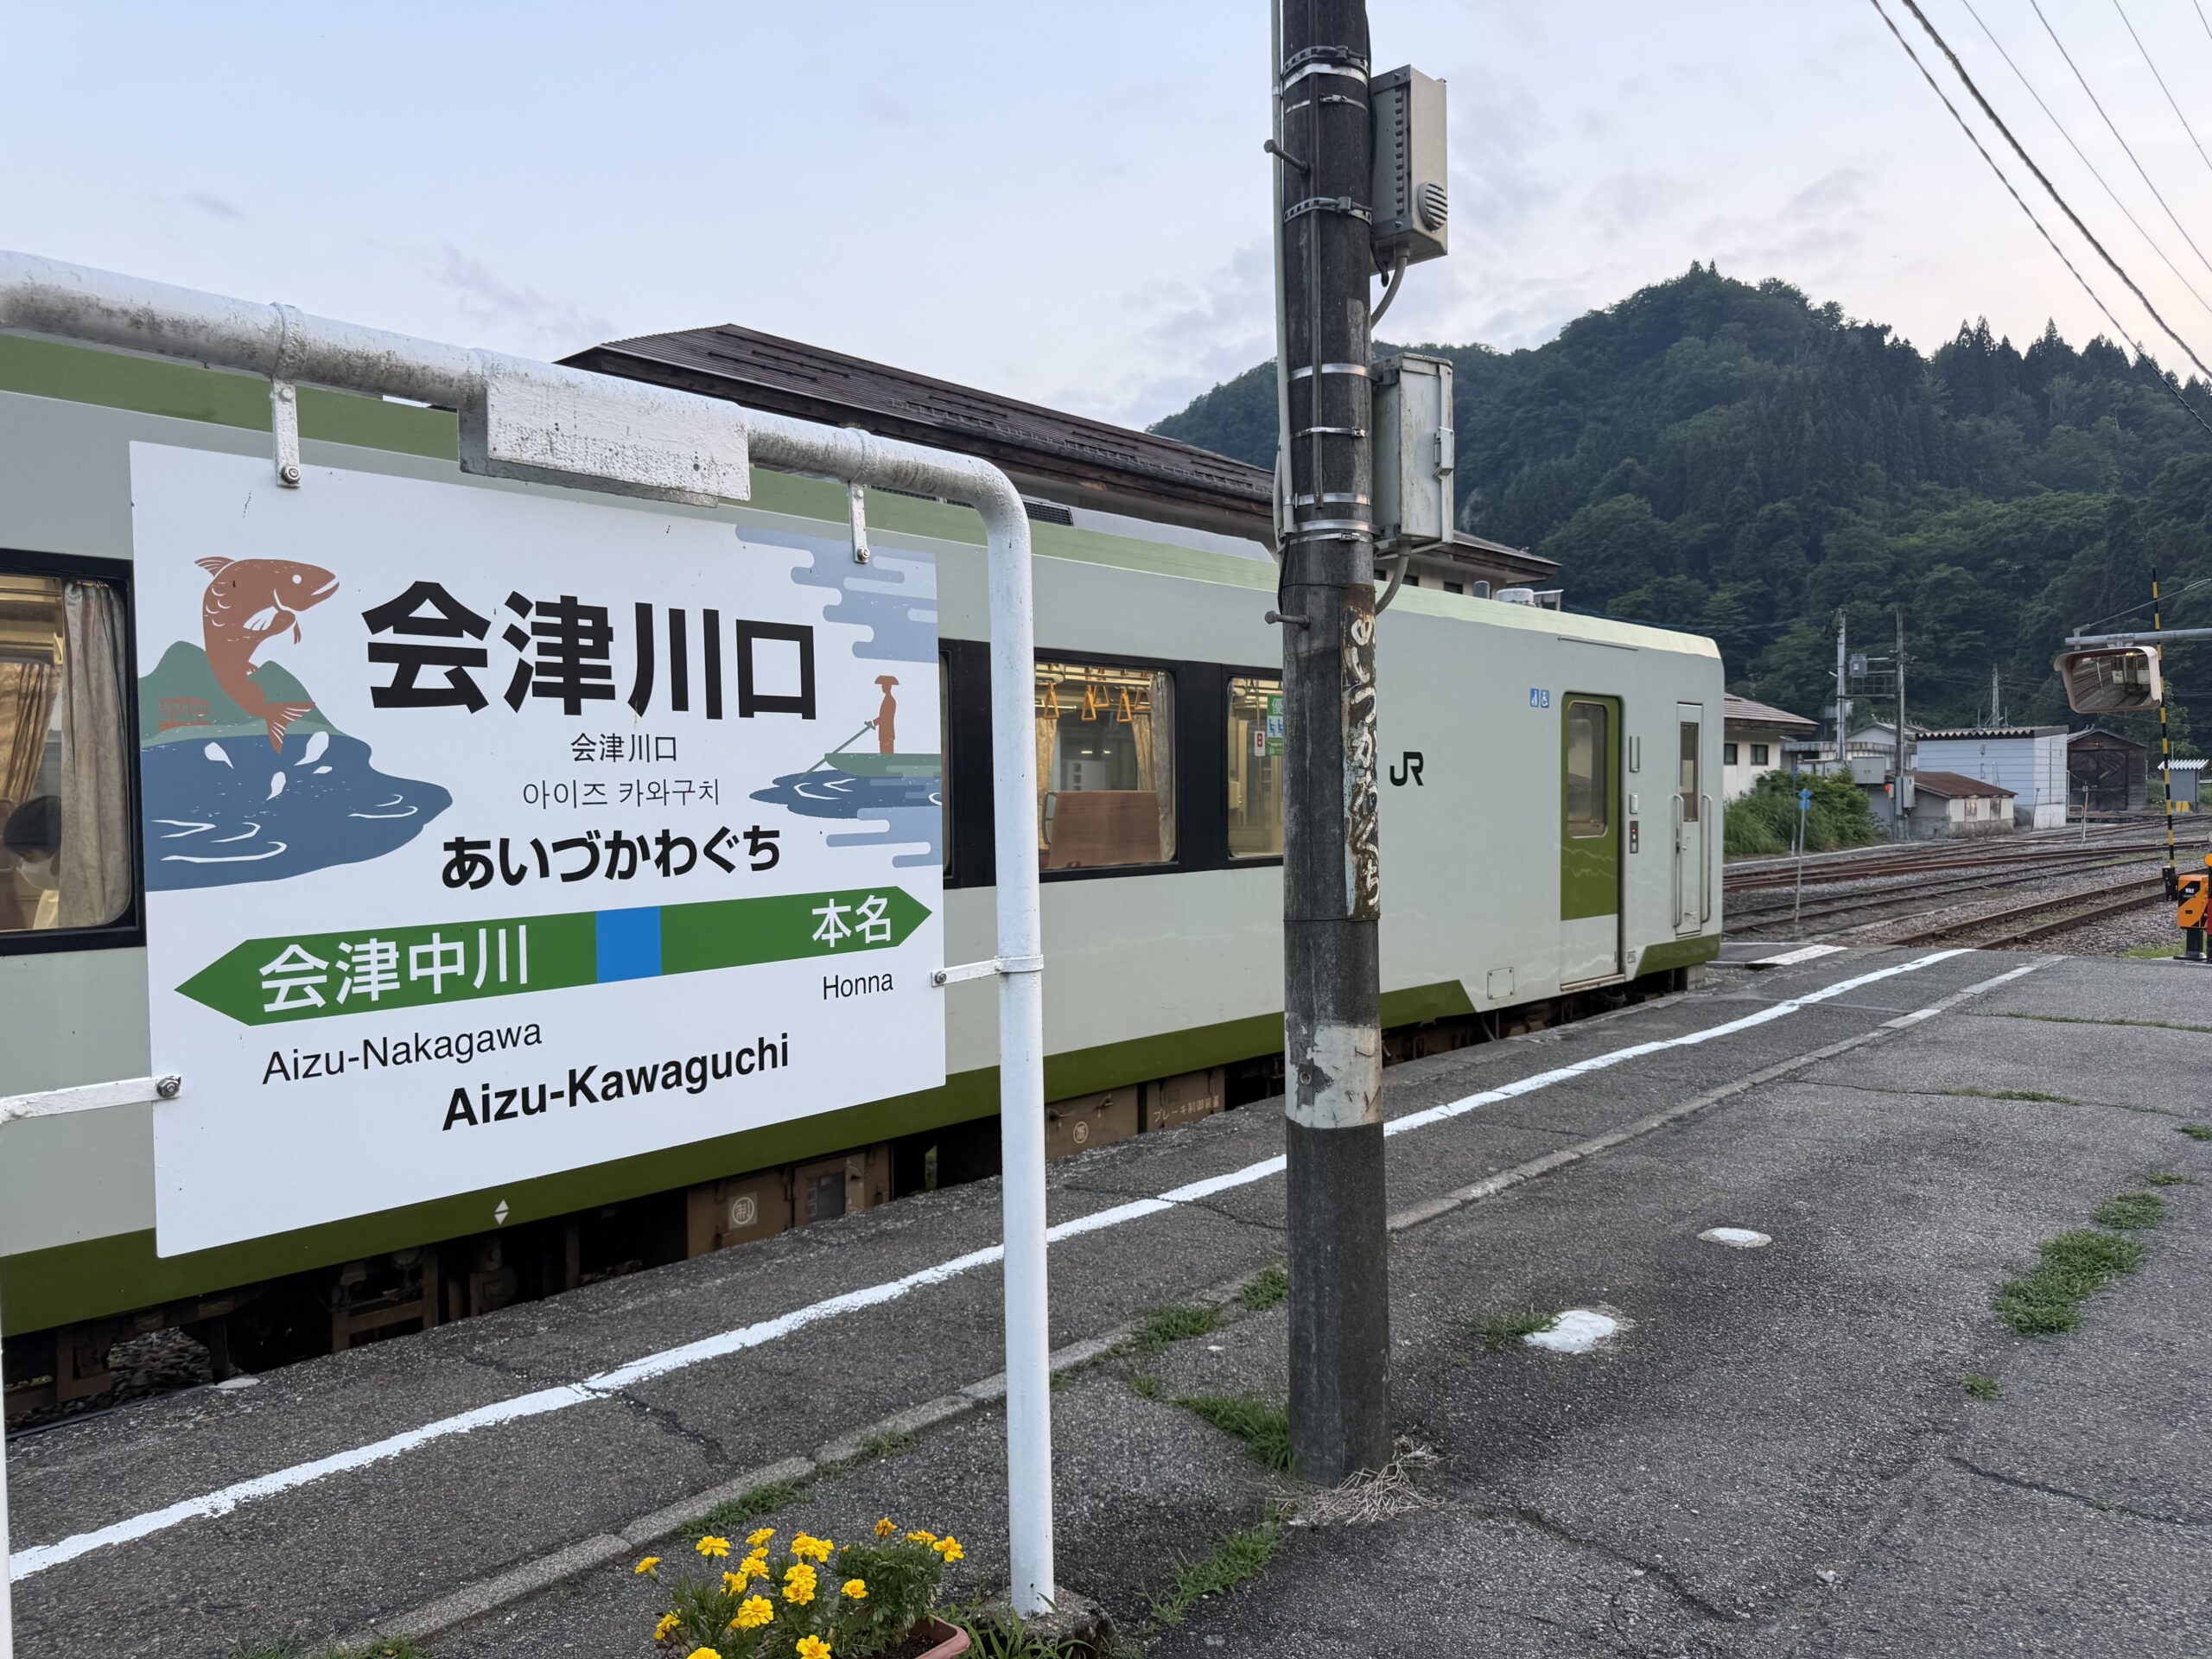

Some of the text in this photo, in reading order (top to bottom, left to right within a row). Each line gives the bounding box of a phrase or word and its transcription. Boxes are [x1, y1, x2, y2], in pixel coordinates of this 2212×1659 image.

[362, 582, 817, 721] 会津川口
[570, 732, 677, 763] 会津川口
[1390, 752, 1424, 786] JR
[523, 778, 719, 810] 아이즈 카와구치
[442, 824, 780, 891] あいづかわぐち
[811, 894, 894, 948] 本名
[258, 924, 529, 1014] 会津中川
[823, 973, 894, 1001] Honna
[262, 1022, 543, 1085] Aizu-Nakagawa
[442, 1033, 790, 1132] Aizu-Kawaguchi
